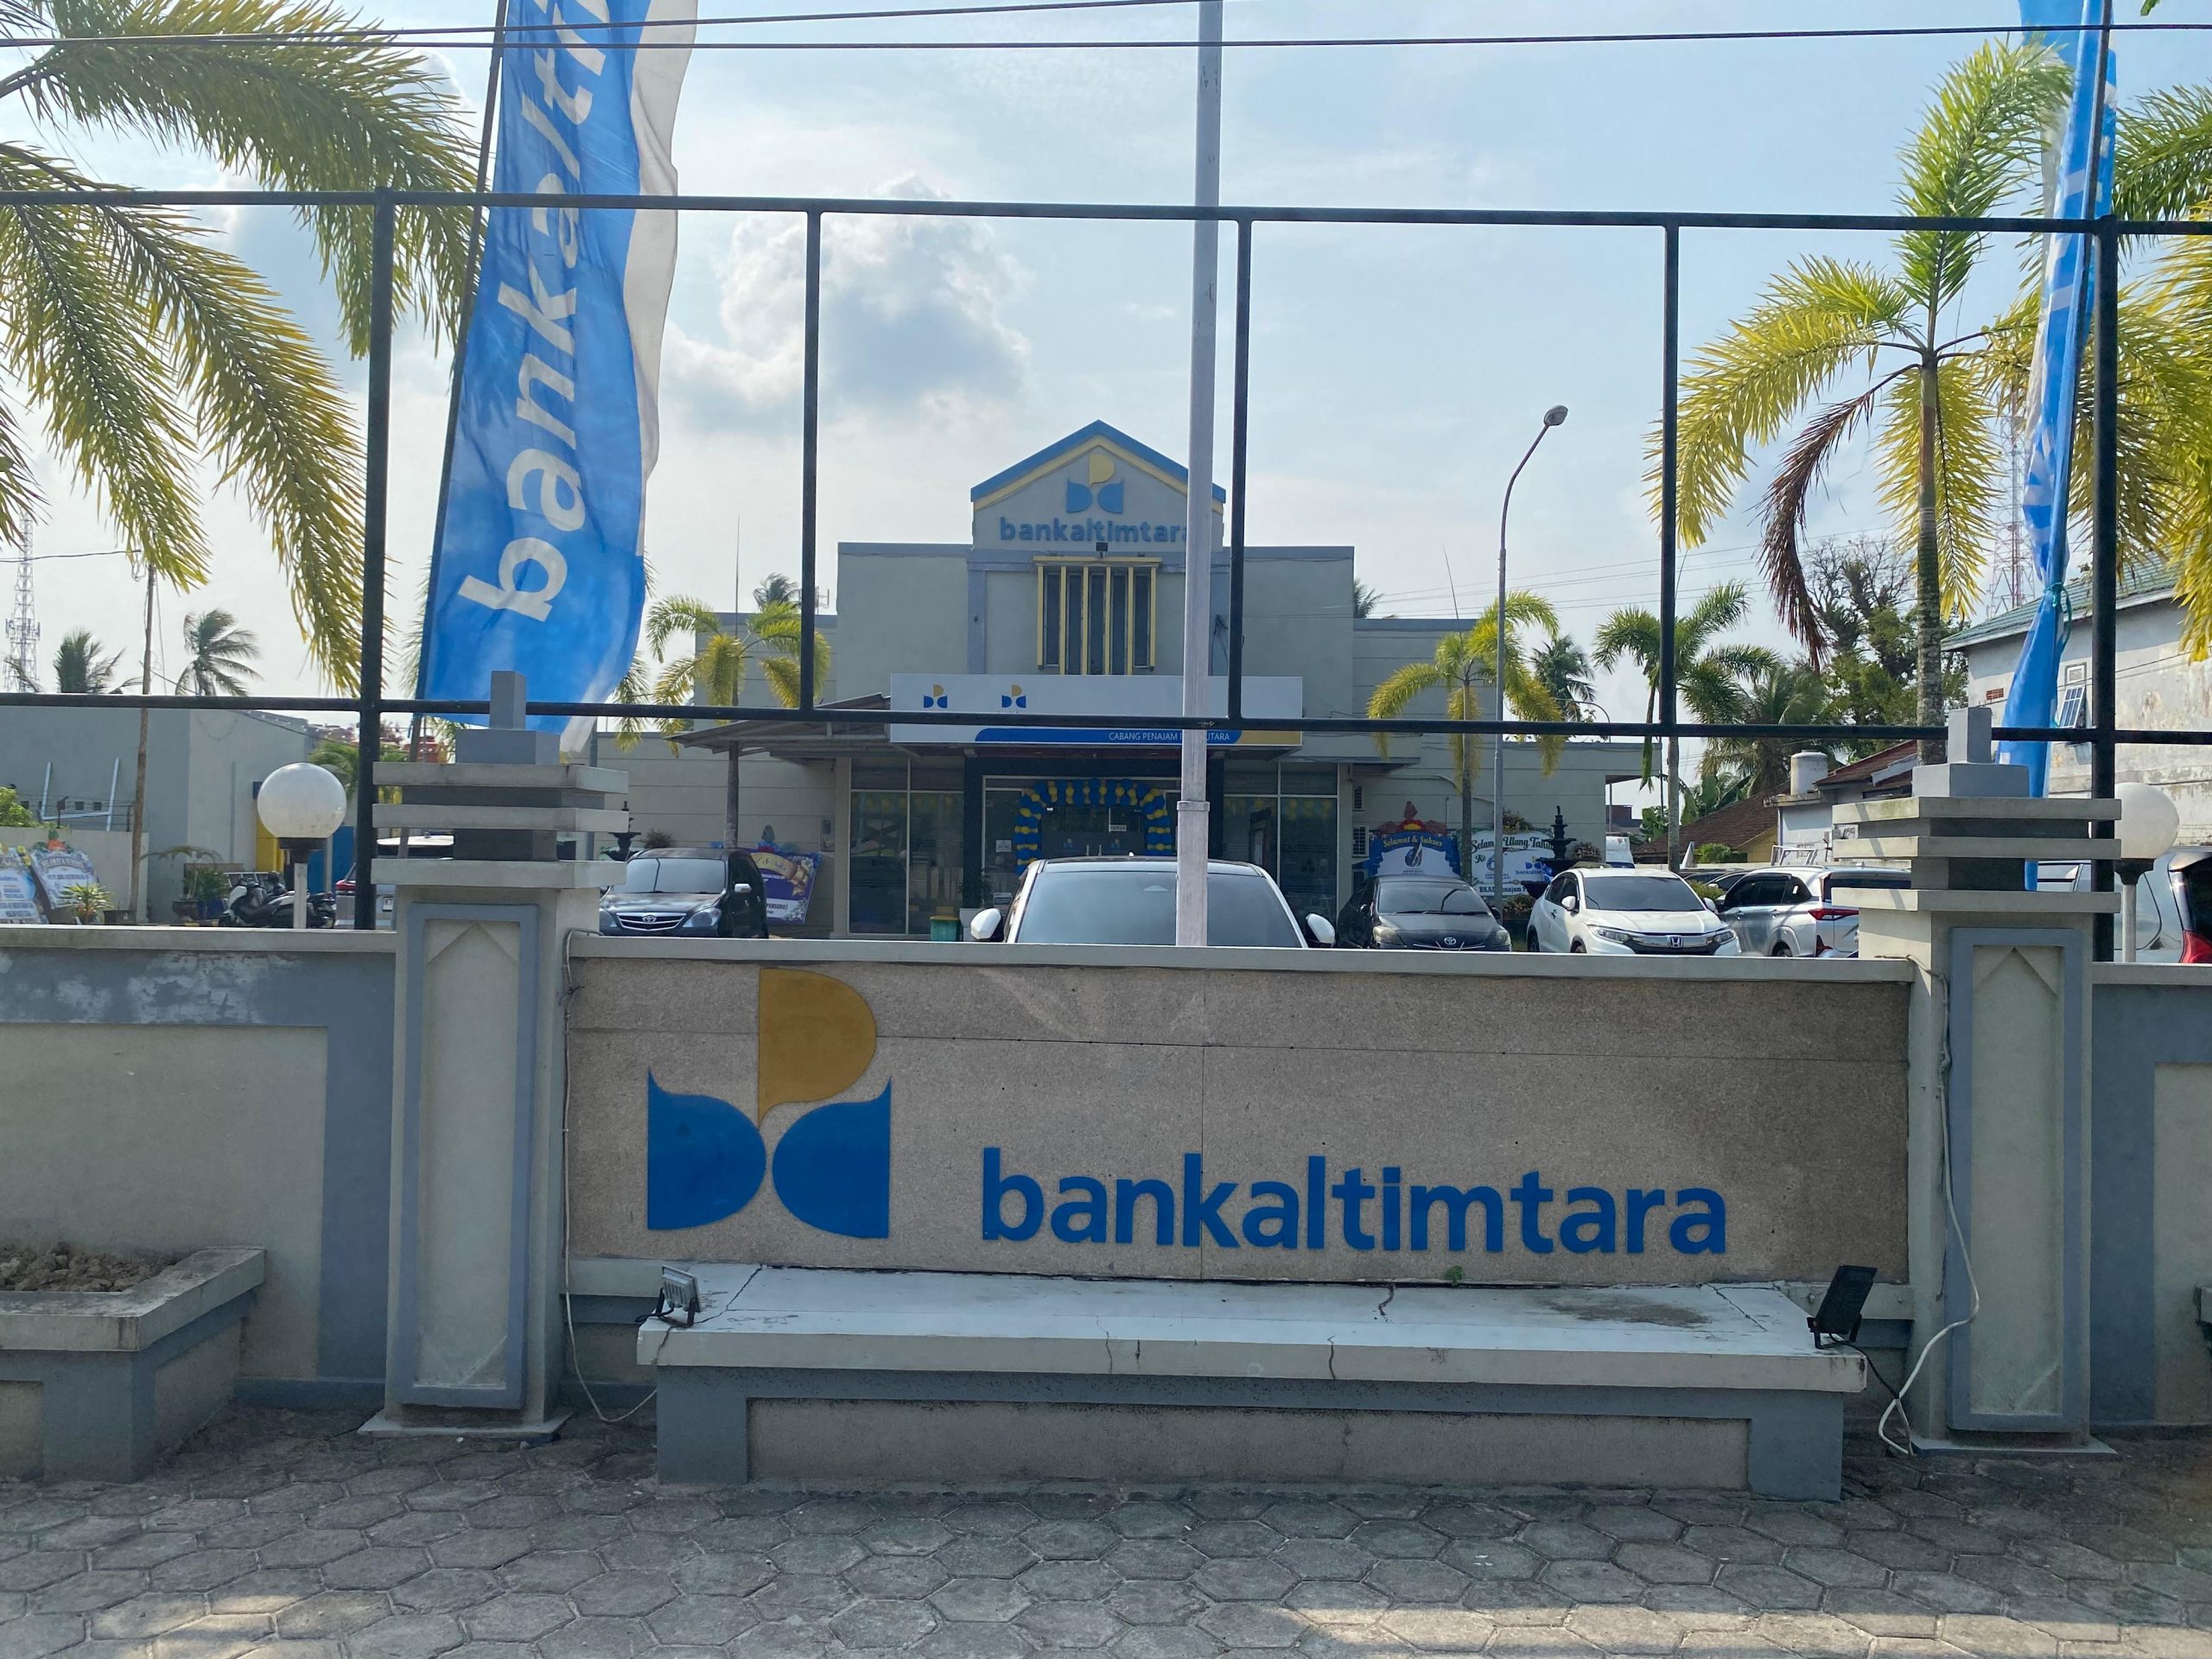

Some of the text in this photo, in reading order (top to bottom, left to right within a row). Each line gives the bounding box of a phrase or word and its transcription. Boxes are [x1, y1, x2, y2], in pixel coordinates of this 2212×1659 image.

[458, 0, 610, 622] bankalti
[1109, 732, 1141, 741] CABANG
[1142, 732, 1178, 741] PENAJAM
[1382, 836, 1410, 847] Selamat
[1420, 836, 1442, 847] Sukses
[1471, 839, 1495, 854] Selam
[1503, 836, 1529, 849] Ulang
[1474, 854, 1486, 864] Ke
[982, 1147, 1726, 1255] bankaltimtara
